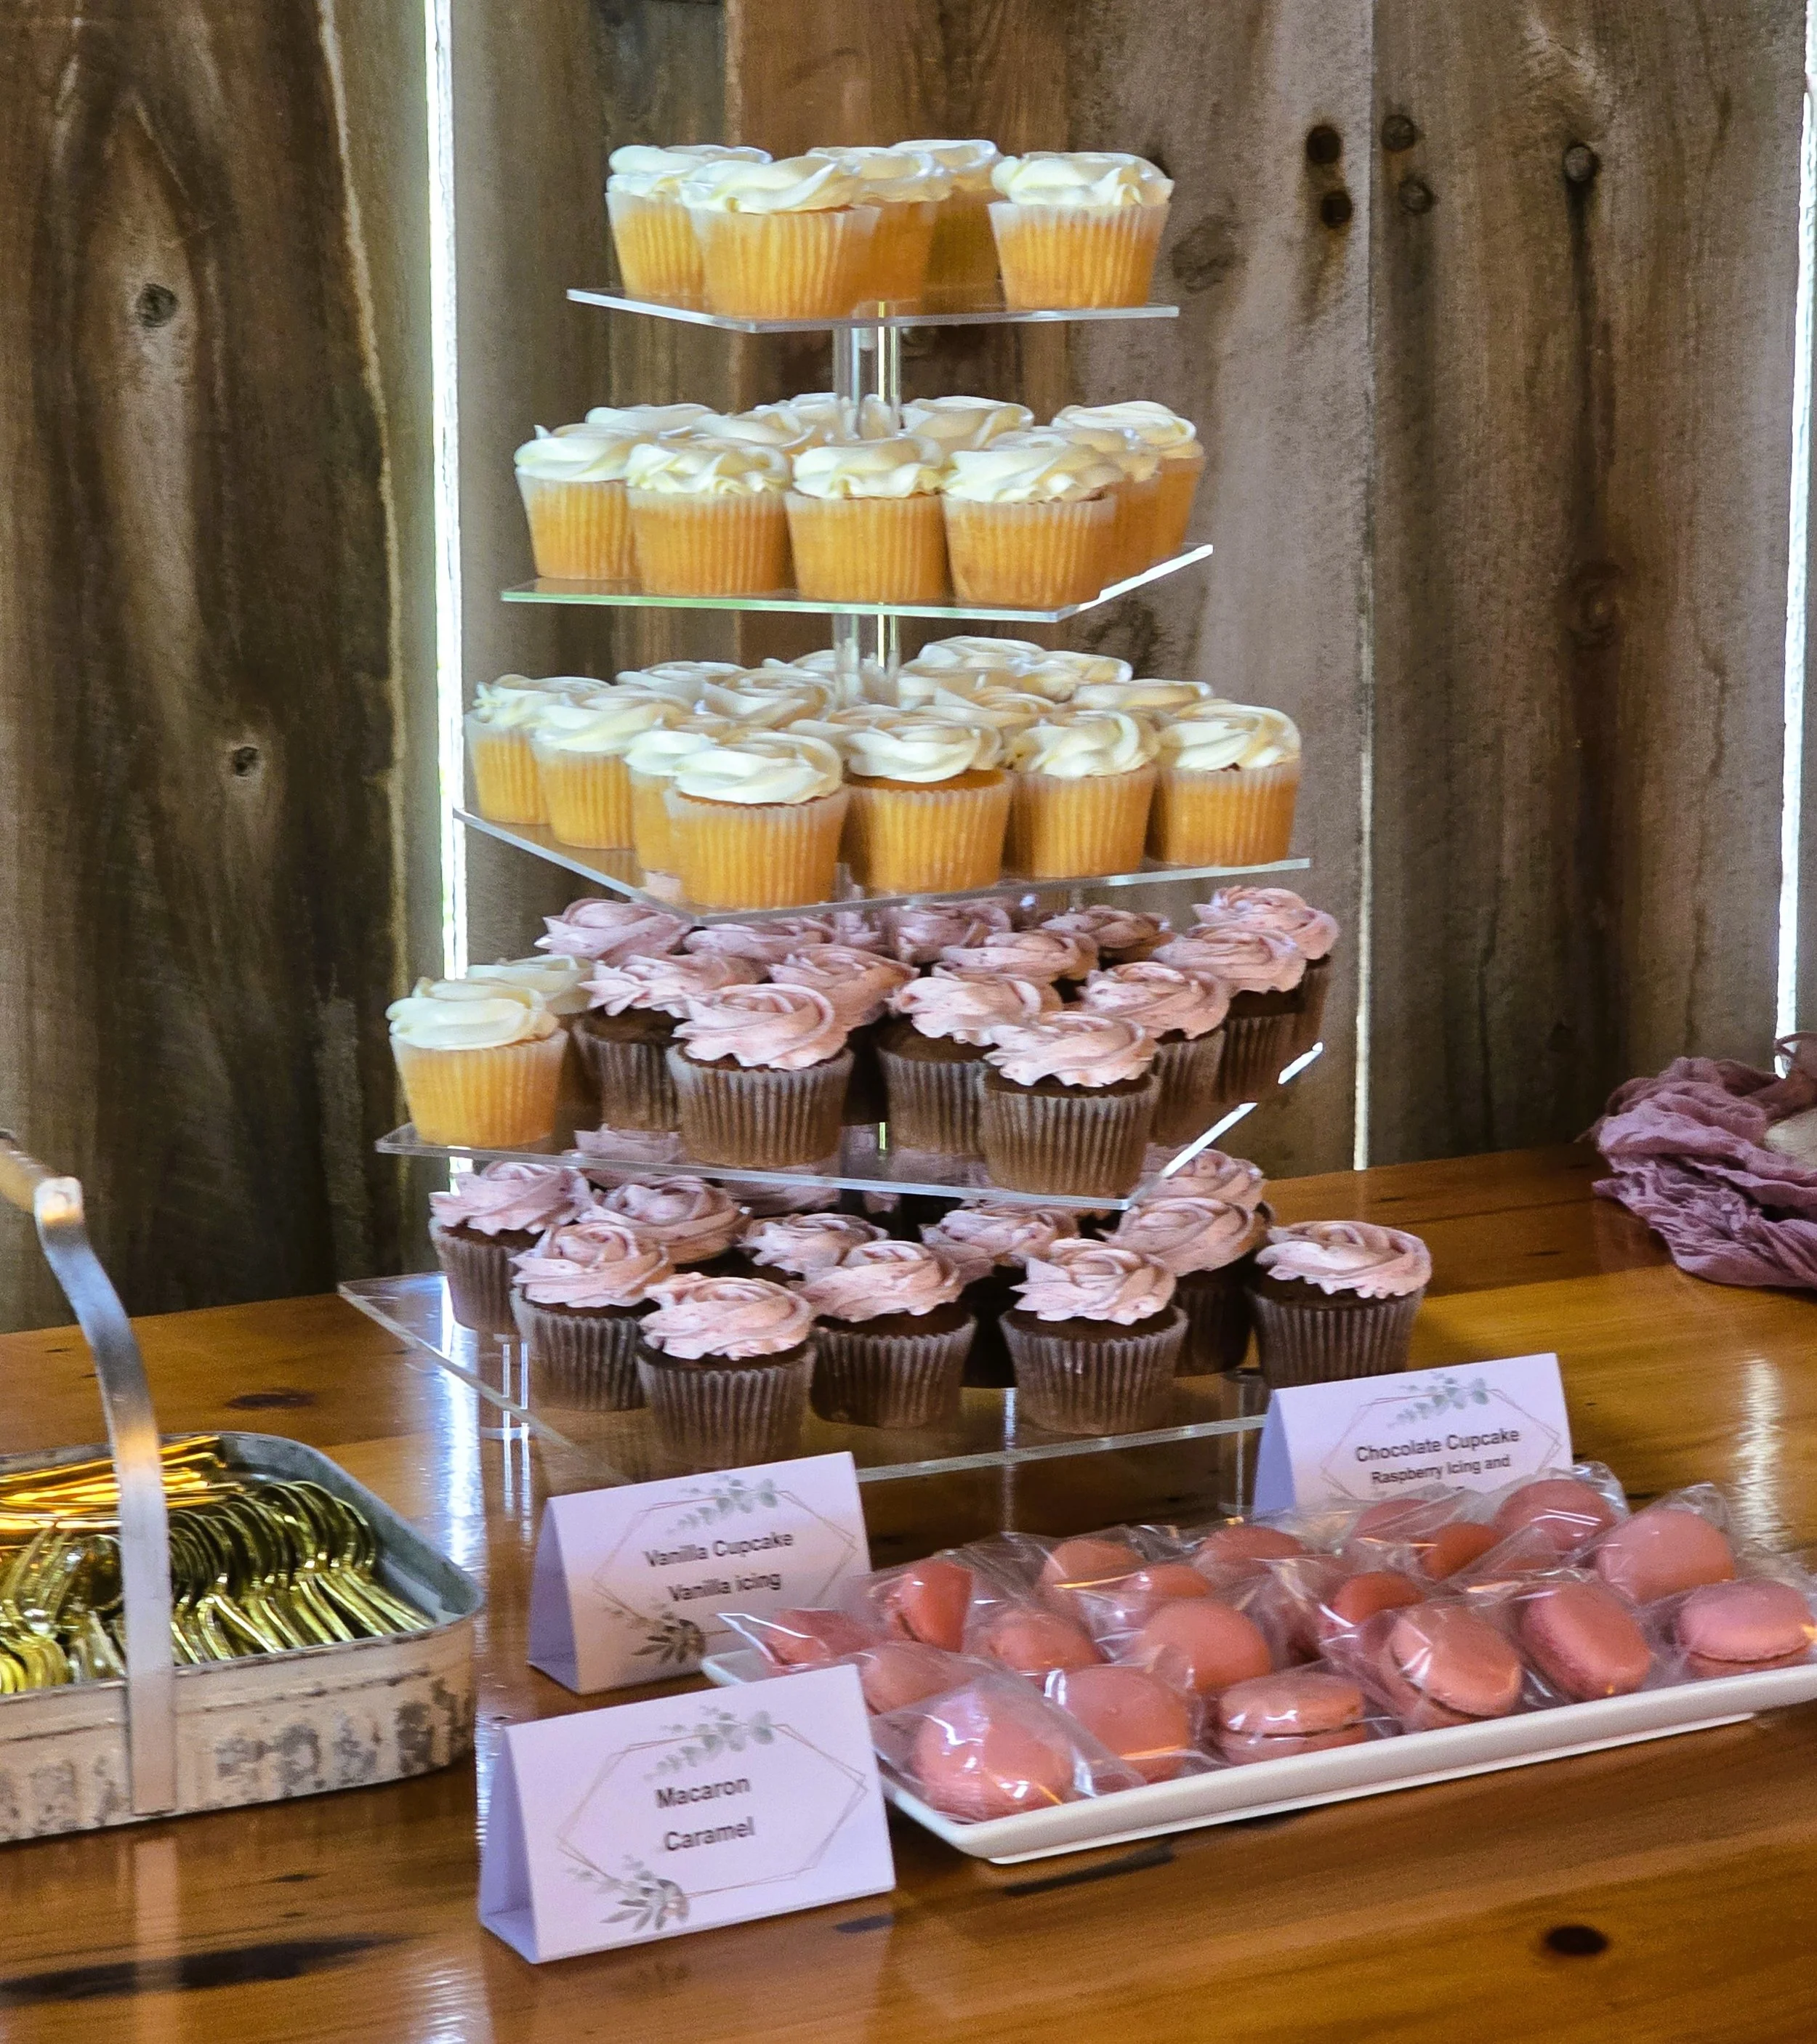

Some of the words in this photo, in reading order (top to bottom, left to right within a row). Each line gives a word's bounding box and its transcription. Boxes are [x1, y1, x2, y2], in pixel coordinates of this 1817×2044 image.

[1355, 1439, 1441, 1461] Chocolate
[1446, 1428, 1520, 1451] Cupcake
[1371, 1466, 1442, 1484] Raspberry
[1484, 1454, 1511, 1469] and
[643, 1543, 709, 1567] Vanilla
[712, 1532, 794, 1557] Cupcake
[666, 1578, 731, 1601] Vanilla
[655, 1778, 751, 1809] Macaron
[663, 1816, 755, 1851] Caramel
